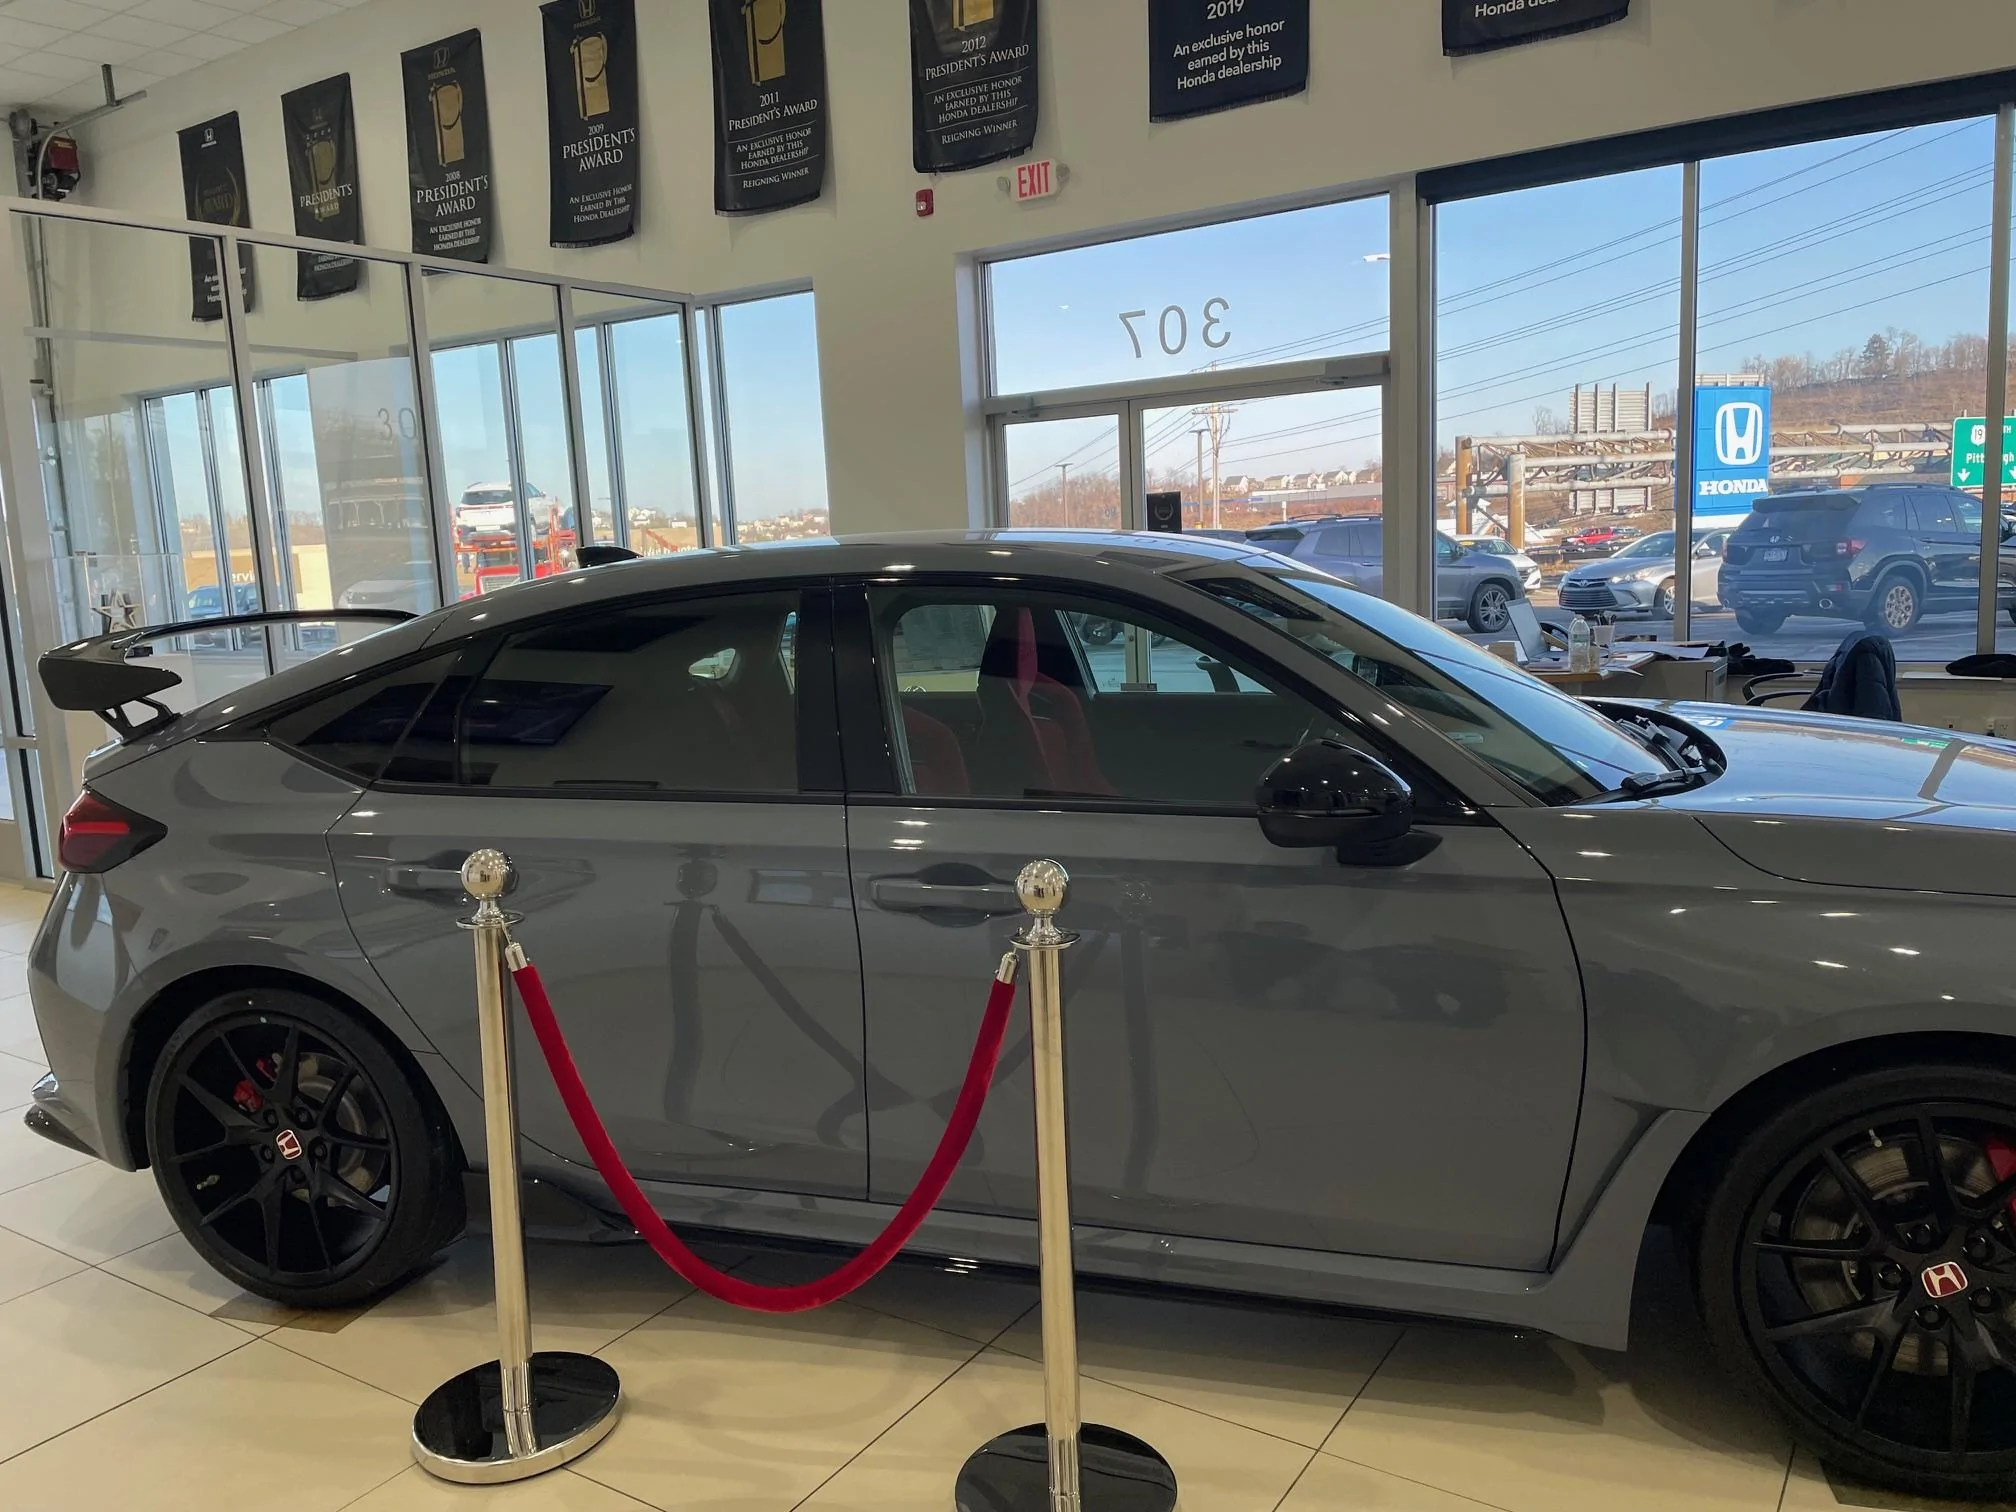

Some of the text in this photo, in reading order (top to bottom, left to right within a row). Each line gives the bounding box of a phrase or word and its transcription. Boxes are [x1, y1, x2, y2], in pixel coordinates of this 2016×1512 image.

[1207, 0, 1244, 20] 2019
[1475, 0, 1525, 18] Honda
[961, 36, 987, 53] 2012
[1173, 20, 1285, 58] An exclusive honor
[925, 44, 1029, 80] PRESIDENT'S AWARD
[1187, 40, 1270, 71] earned by this
[1177, 55, 1282, 90] Honda dealership
[760, 92, 779, 106] 2011
[933, 75, 1022, 104] AN EXCLUSIVE HONOR
[945, 89, 1011, 111] EARNED BY THIS
[729, 99, 818, 130] PRESIDENT'S AWARD
[938, 97, 1018, 123] HONDA DEALERSHIP
[588, 123, 604, 135] 2009
[736, 128, 812, 152] AN EXCLUSIVE HONOR
[941, 119, 1018, 144] REIGNING WINNER
[563, 128, 635, 158] PRESIDENT'S
[748, 140, 803, 159] EARNED BY THIS
[579, 149, 623, 172] AWARD
[741, 147, 809, 170] HONDA DEALERSHIP
[416, 175, 488, 203] PRESIDENT'S
[743, 167, 809, 188] REIGNING WINNER
[1018, 161, 1050, 198] EXIT
[300, 183, 352, 208] PRESIDENT'S
[435, 196, 476, 217] AWARD
[569, 196, 580, 204] AN
[581, 190, 612, 202] EXCLUSIVE
[580, 202, 604, 212] EARNED
[614, 196, 626, 205] THIS
[573, 213, 599, 223] HONDA
[1974, 428, 1983, 441] 19
[1699, 478, 1769, 496] HONDA
